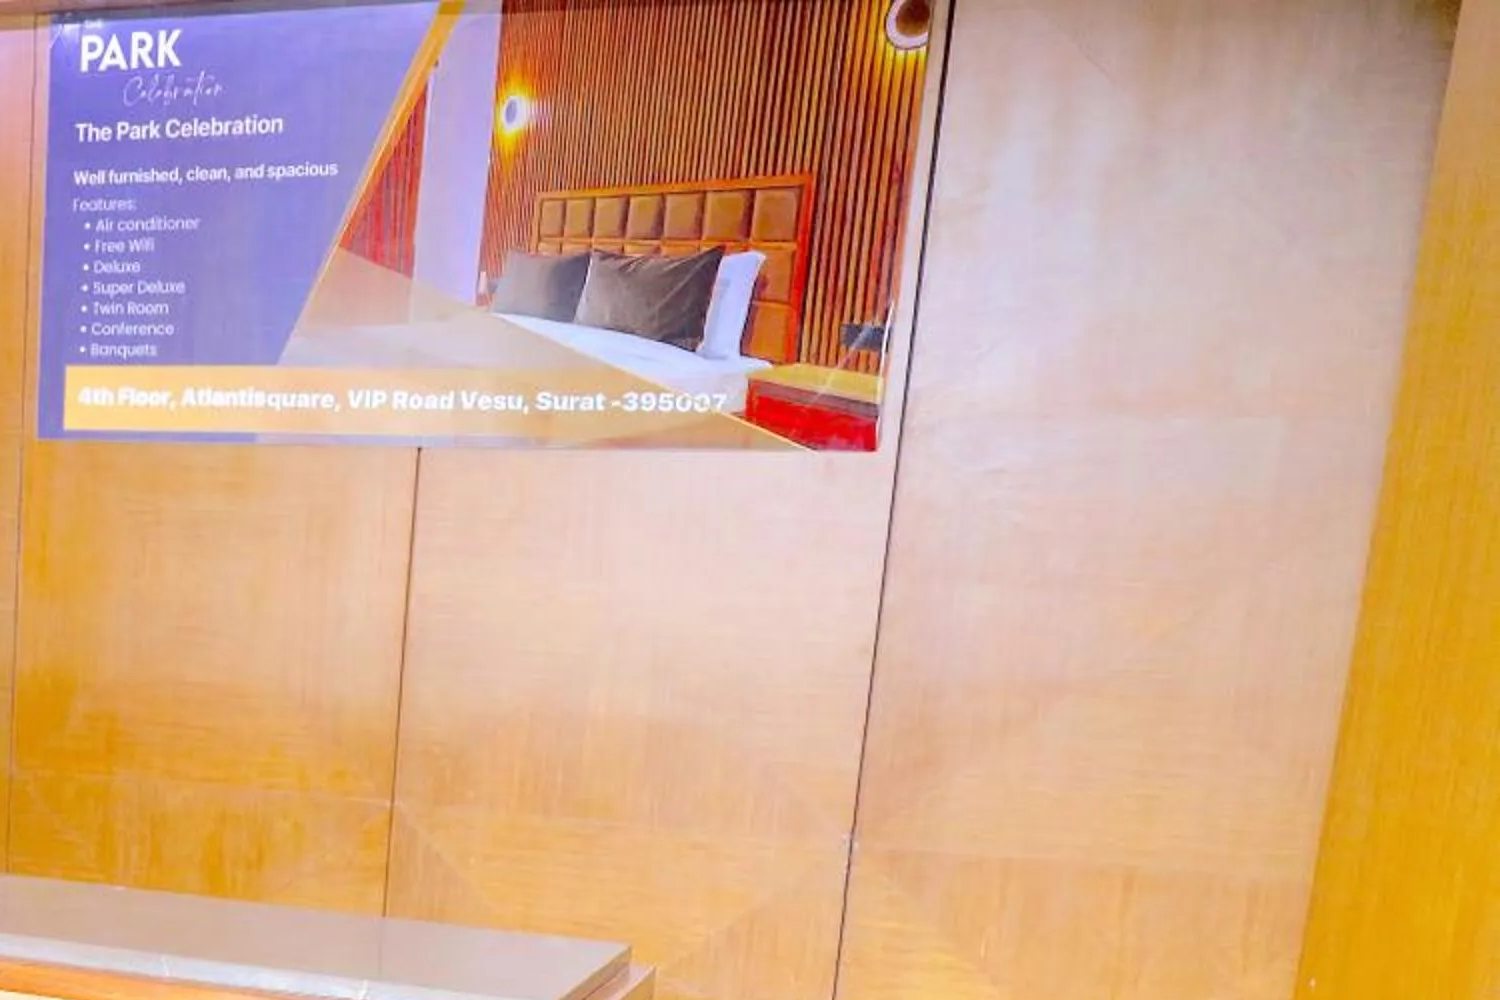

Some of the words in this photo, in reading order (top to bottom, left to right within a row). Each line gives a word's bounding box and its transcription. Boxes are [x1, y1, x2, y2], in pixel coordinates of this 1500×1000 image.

[80, 29, 182, 73] PARK
[75, 123, 113, 143] The
[116, 119, 161, 141] Park
[165, 114, 284, 139] Celebration
[73, 170, 105, 186] Well
[108, 166, 182, 186] furnished,
[186, 165, 231, 184] clean,
[235, 163, 265, 180] and
[267, 161, 339, 181] spacious
[72, 198, 137, 213] Features:
[95, 218, 113, 232] Air
[117, 215, 200, 232] conditioner
[94, 239, 125, 253] Free
[93, 260, 141, 274] Deluxe
[92, 282, 133, 298] Super
[137, 280, 186, 295] Deluxe
[93, 301, 124, 315] Twin
[127, 301, 169, 315] Room
[91, 321, 175, 336] Conference
[90, 342, 158, 359] Banquets
[78, 386, 115, 407] 4th
[117, 386, 177, 410] Floor,
[181, 386, 340, 413] Atlantisquare,
[348, 389, 387, 409] VIP
[392, 390, 454, 410] Road
[461, 390, 529, 414] Vesu,
[536, 390, 605, 411] Surat
